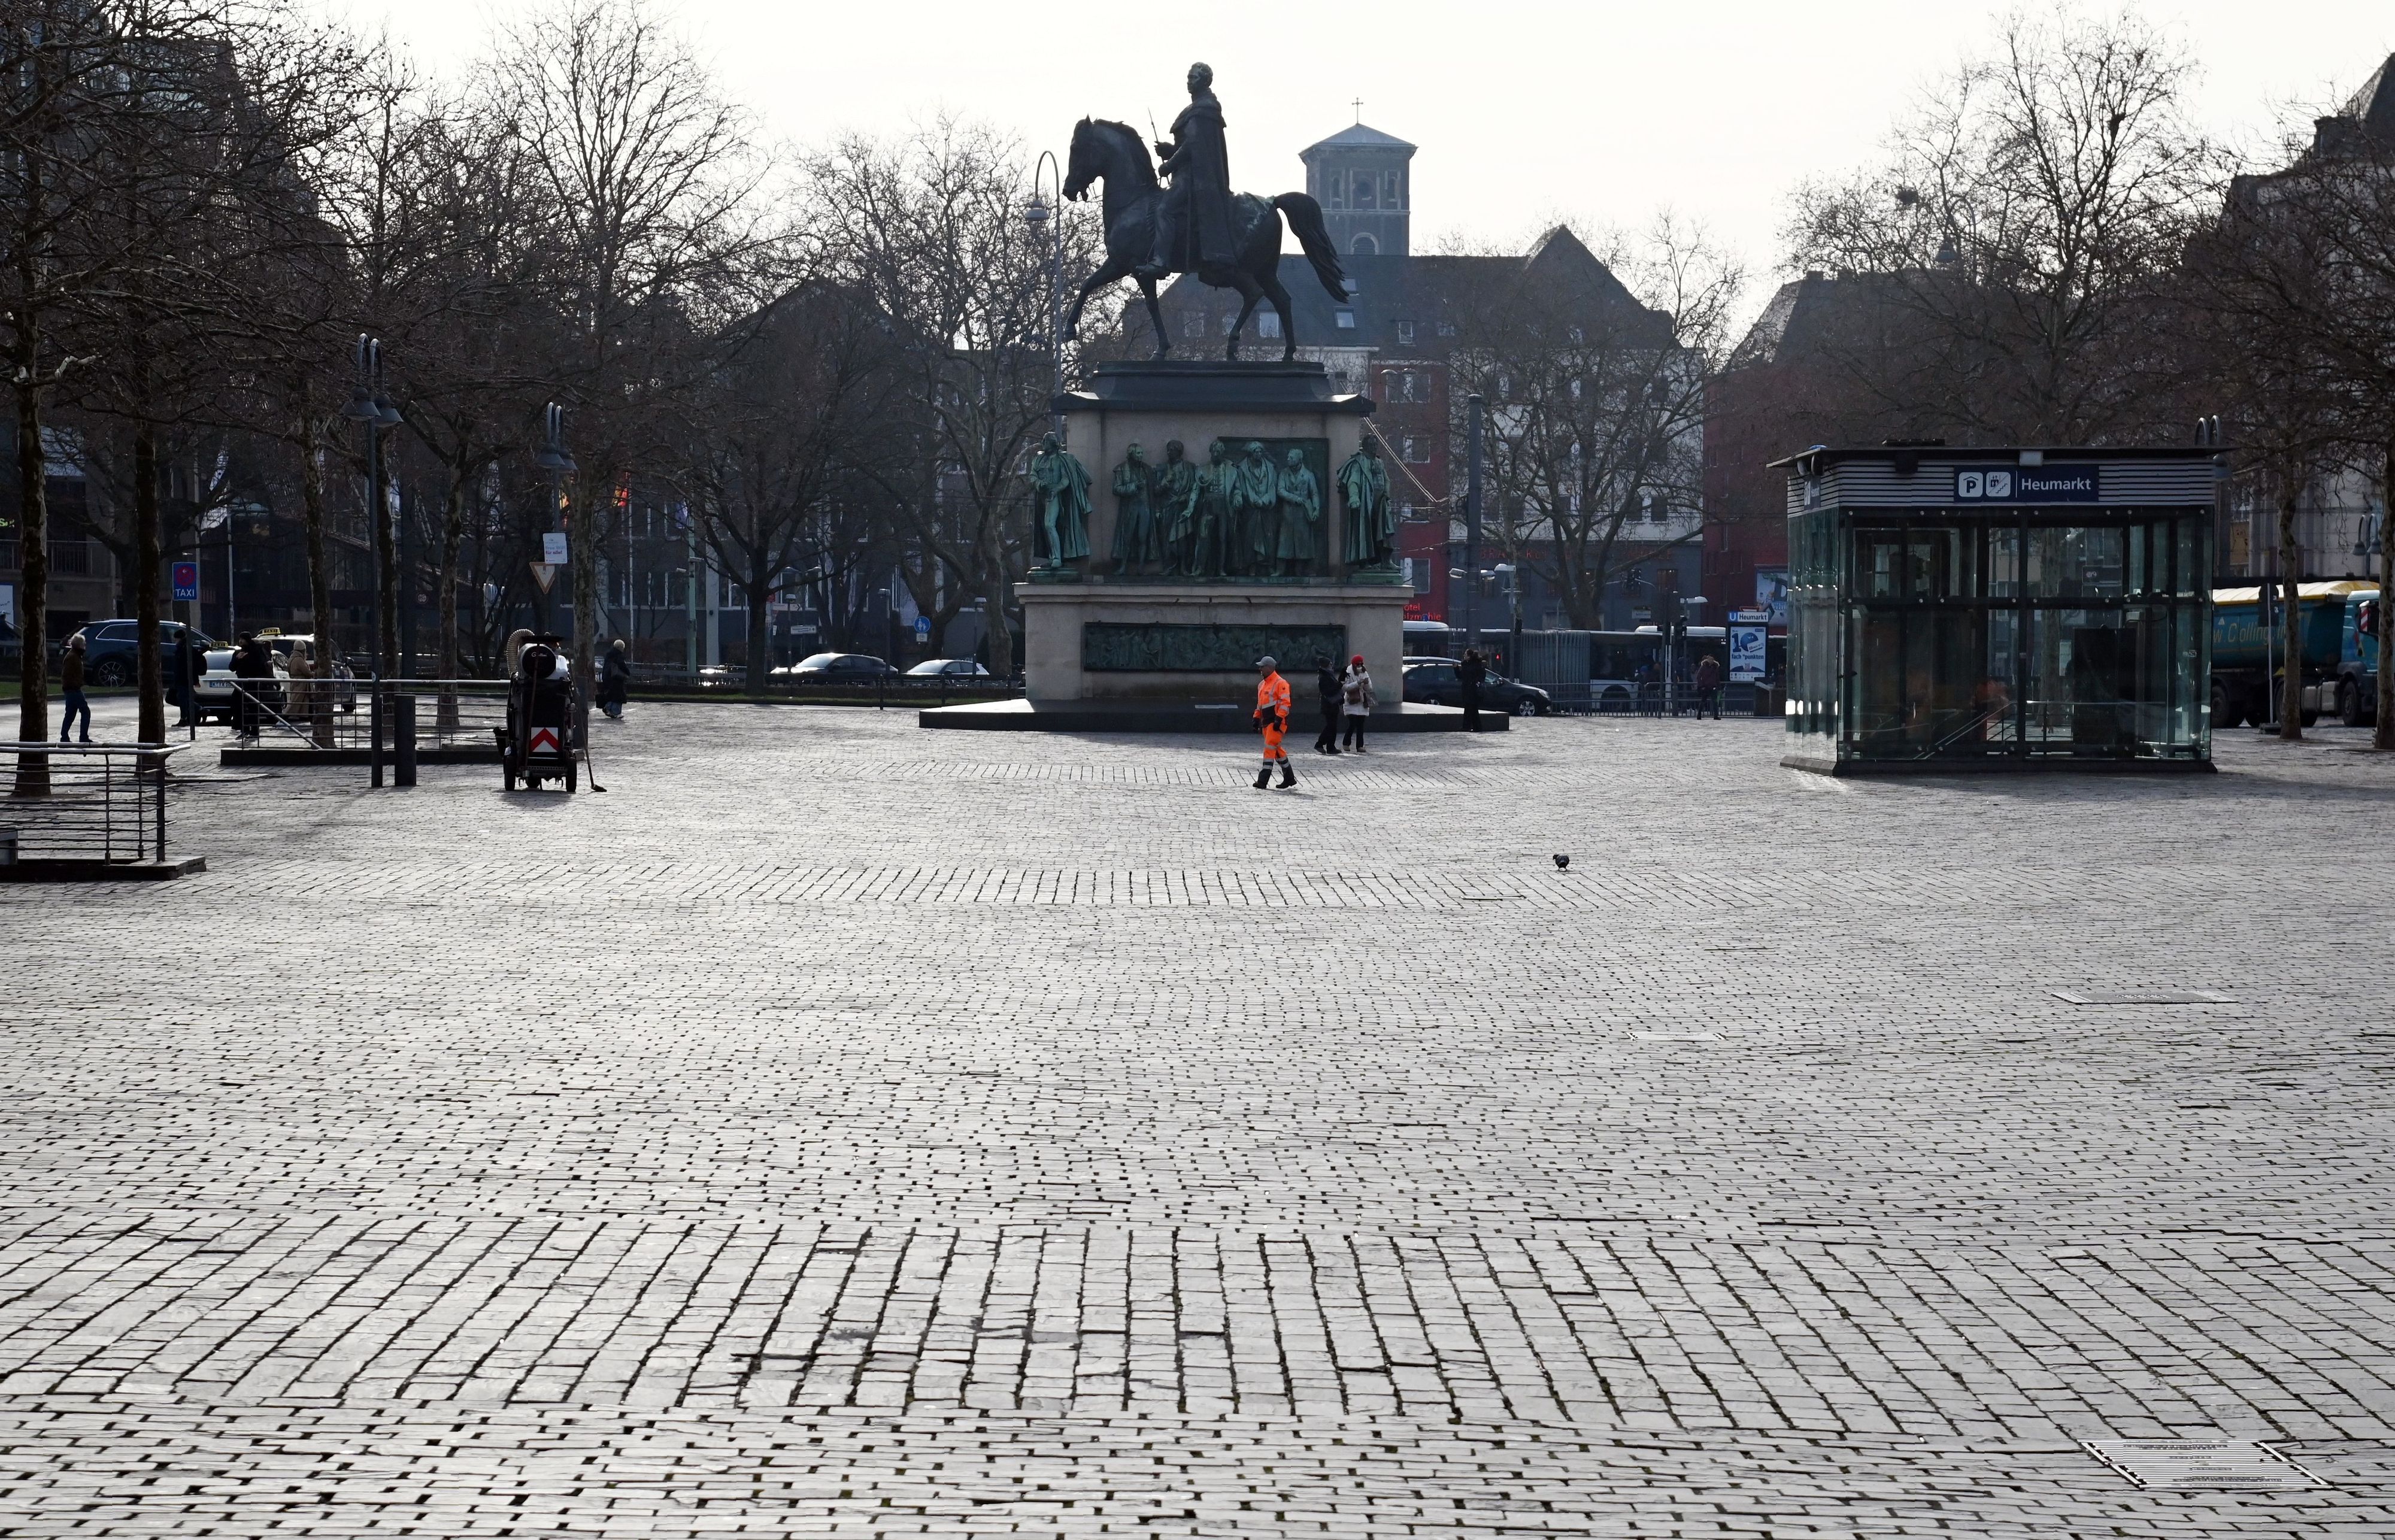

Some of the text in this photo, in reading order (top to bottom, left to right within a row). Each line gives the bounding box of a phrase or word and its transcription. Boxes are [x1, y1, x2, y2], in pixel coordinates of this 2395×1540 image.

[2021, 477, 2091, 490] Heumarkt
[175, 589, 195, 598] TAXI
[1403, 603, 1421, 611] otel
[1729, 613, 1736, 621] U
